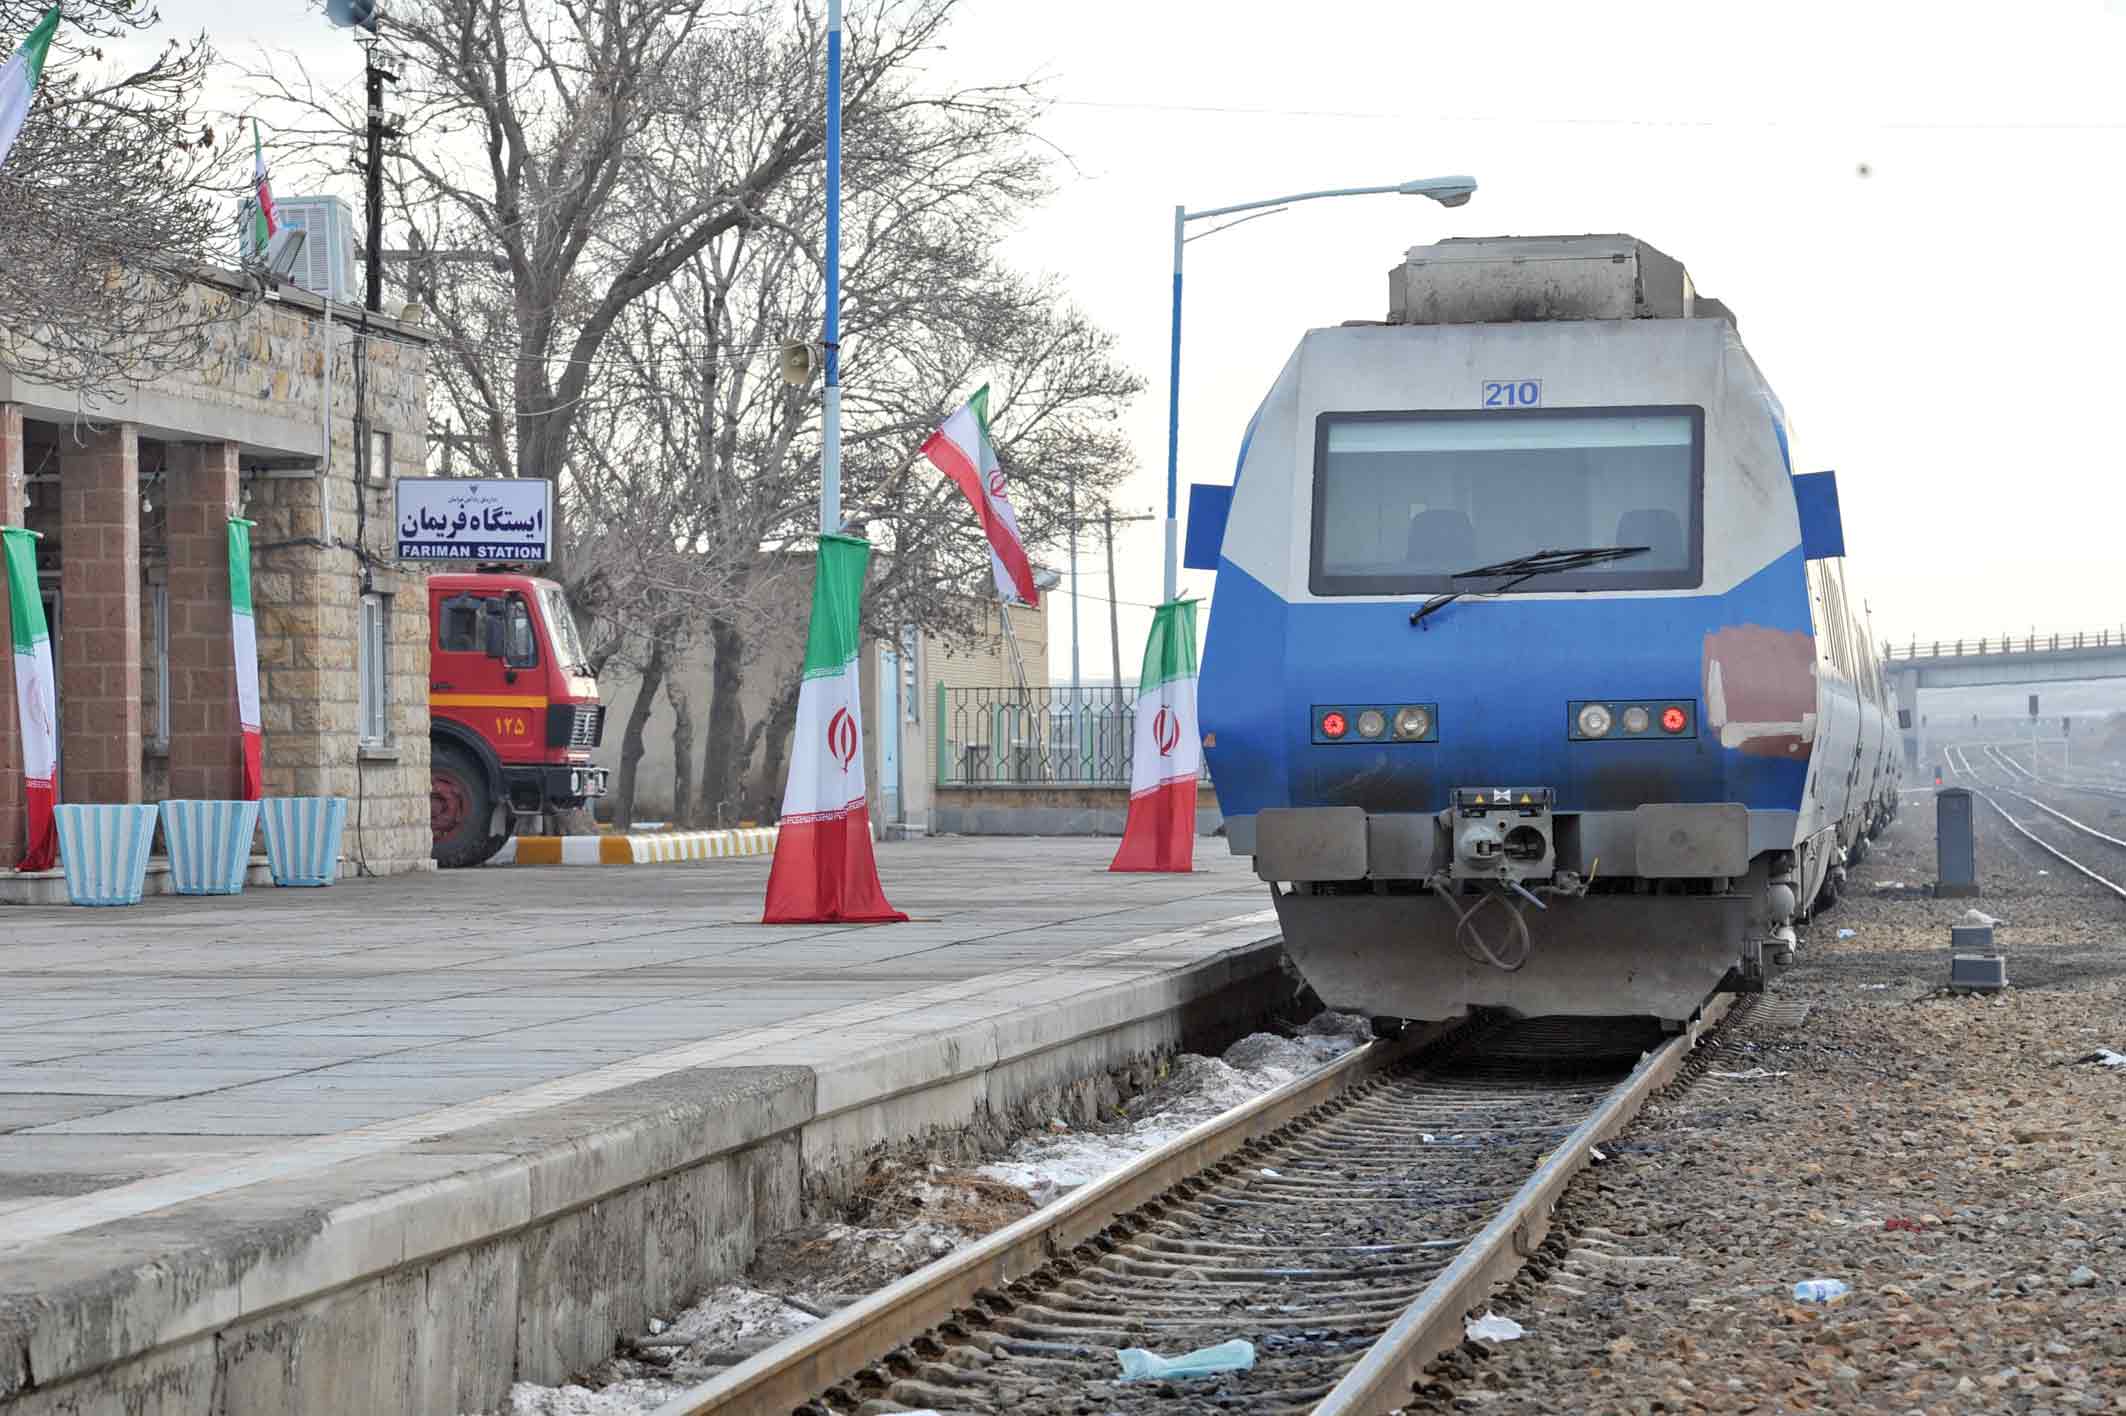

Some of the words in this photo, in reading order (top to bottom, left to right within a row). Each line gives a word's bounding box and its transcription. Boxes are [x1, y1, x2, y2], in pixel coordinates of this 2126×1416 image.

[1486, 382, 1538, 405] 210
[402, 504, 467, 539] فریمان
[471, 506, 543, 539] ایستگاه
[402, 545, 470, 557] FARIMAN
[477, 546, 542, 559] STATION
